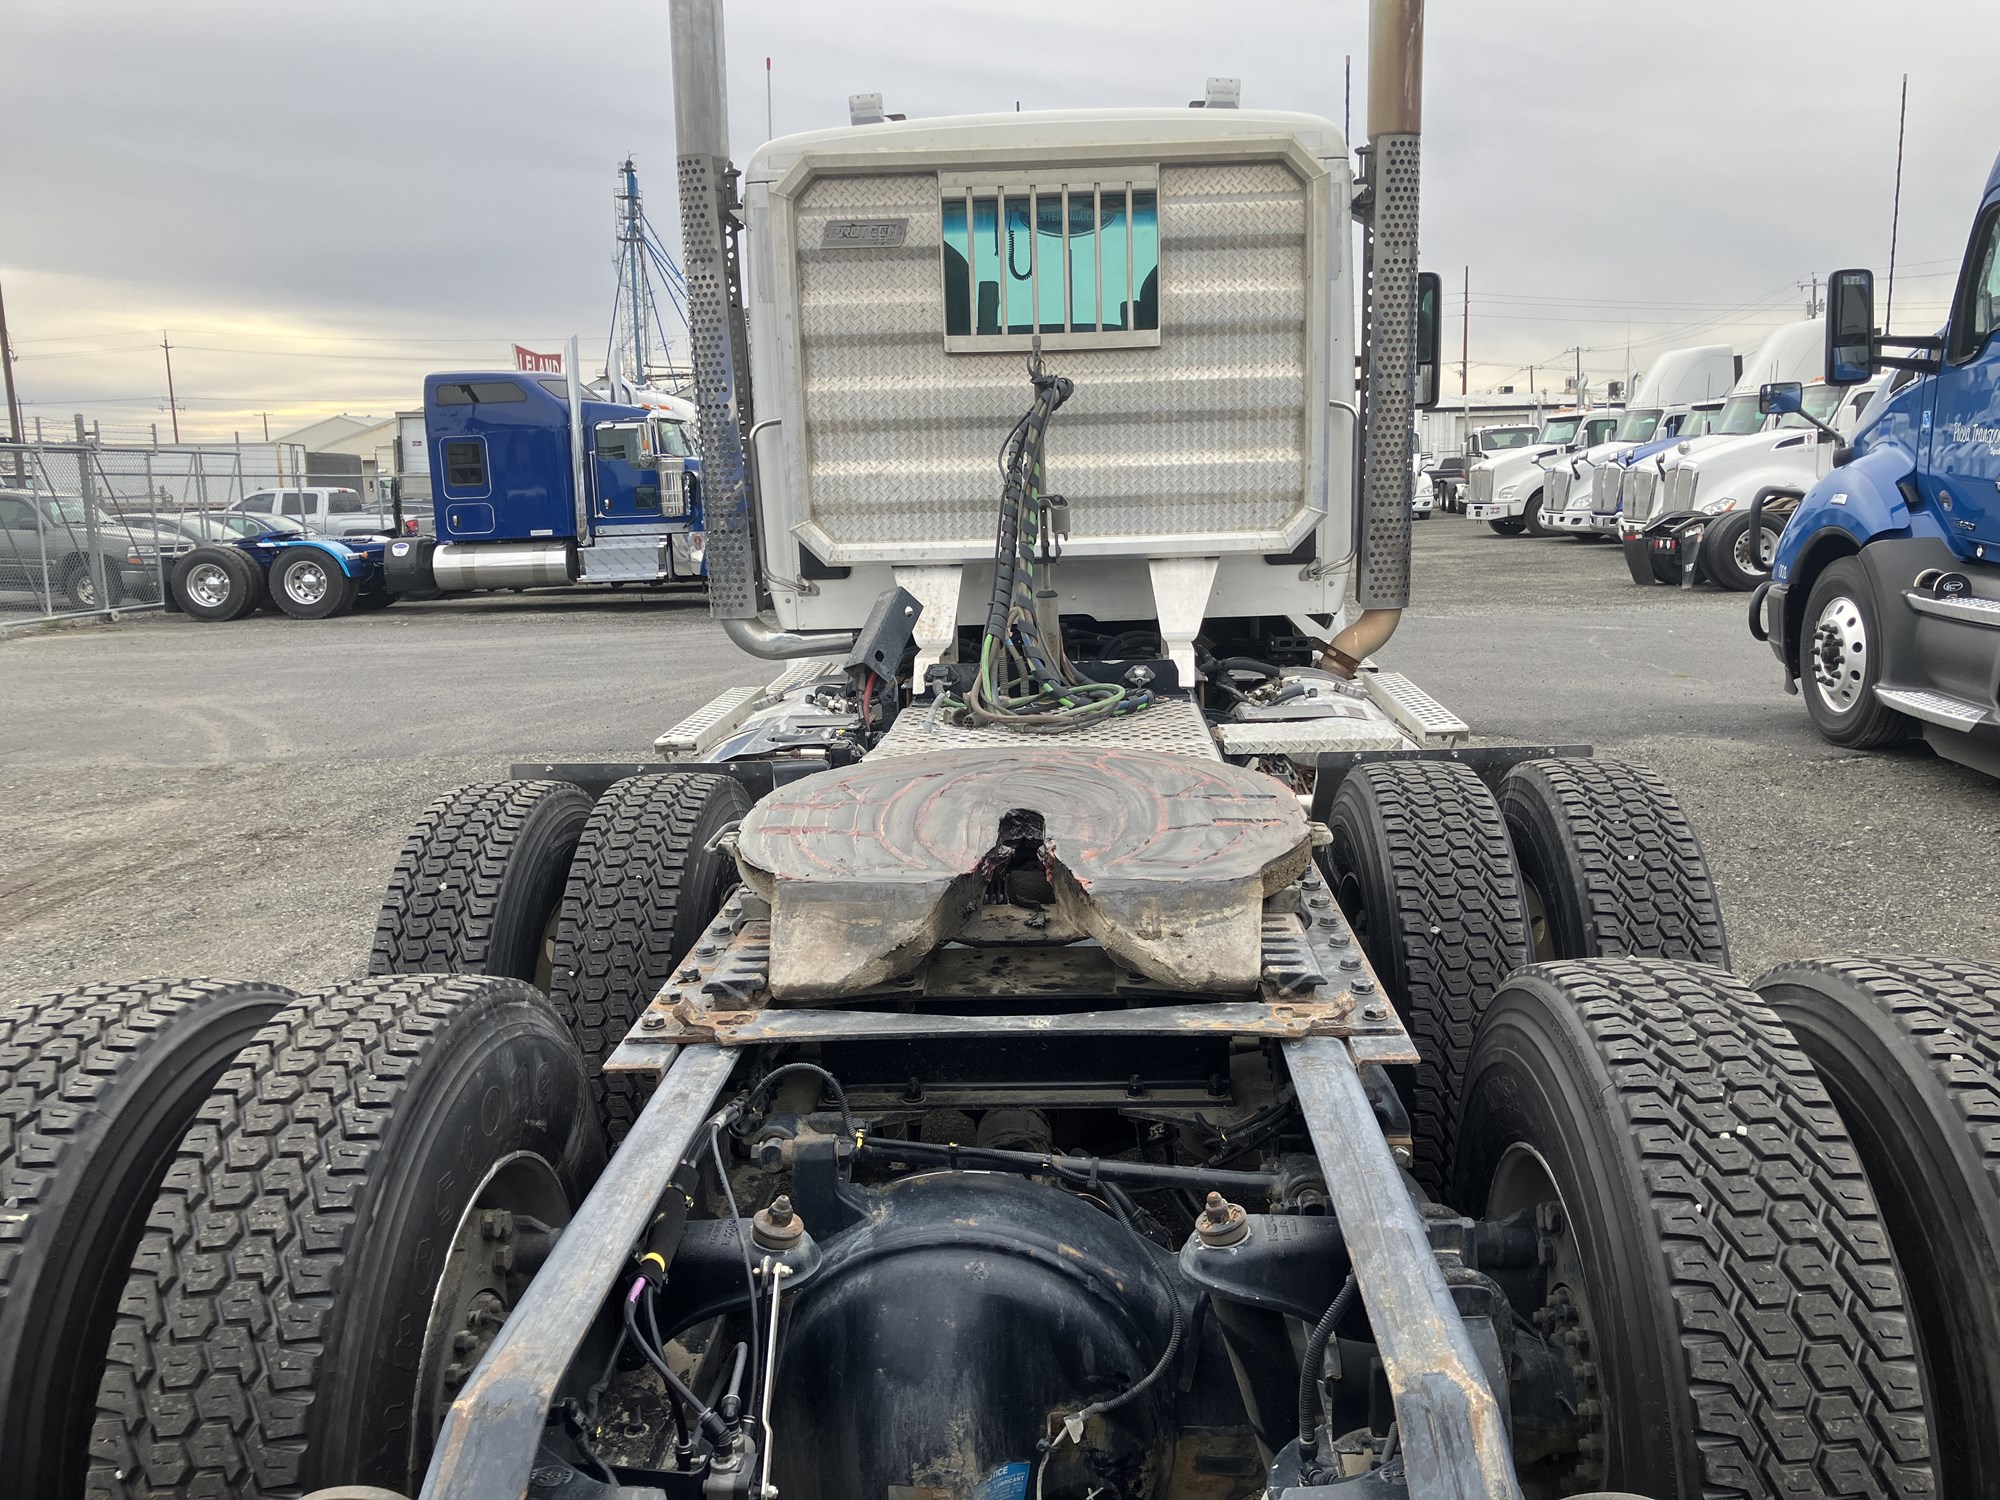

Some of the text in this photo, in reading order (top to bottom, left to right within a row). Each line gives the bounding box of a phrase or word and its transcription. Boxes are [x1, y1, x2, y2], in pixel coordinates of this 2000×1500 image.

[829, 224, 900, 238] PROTECH
[519, 353, 560, 373] LELAND
[988, 1465, 1009, 1482] OTICE
